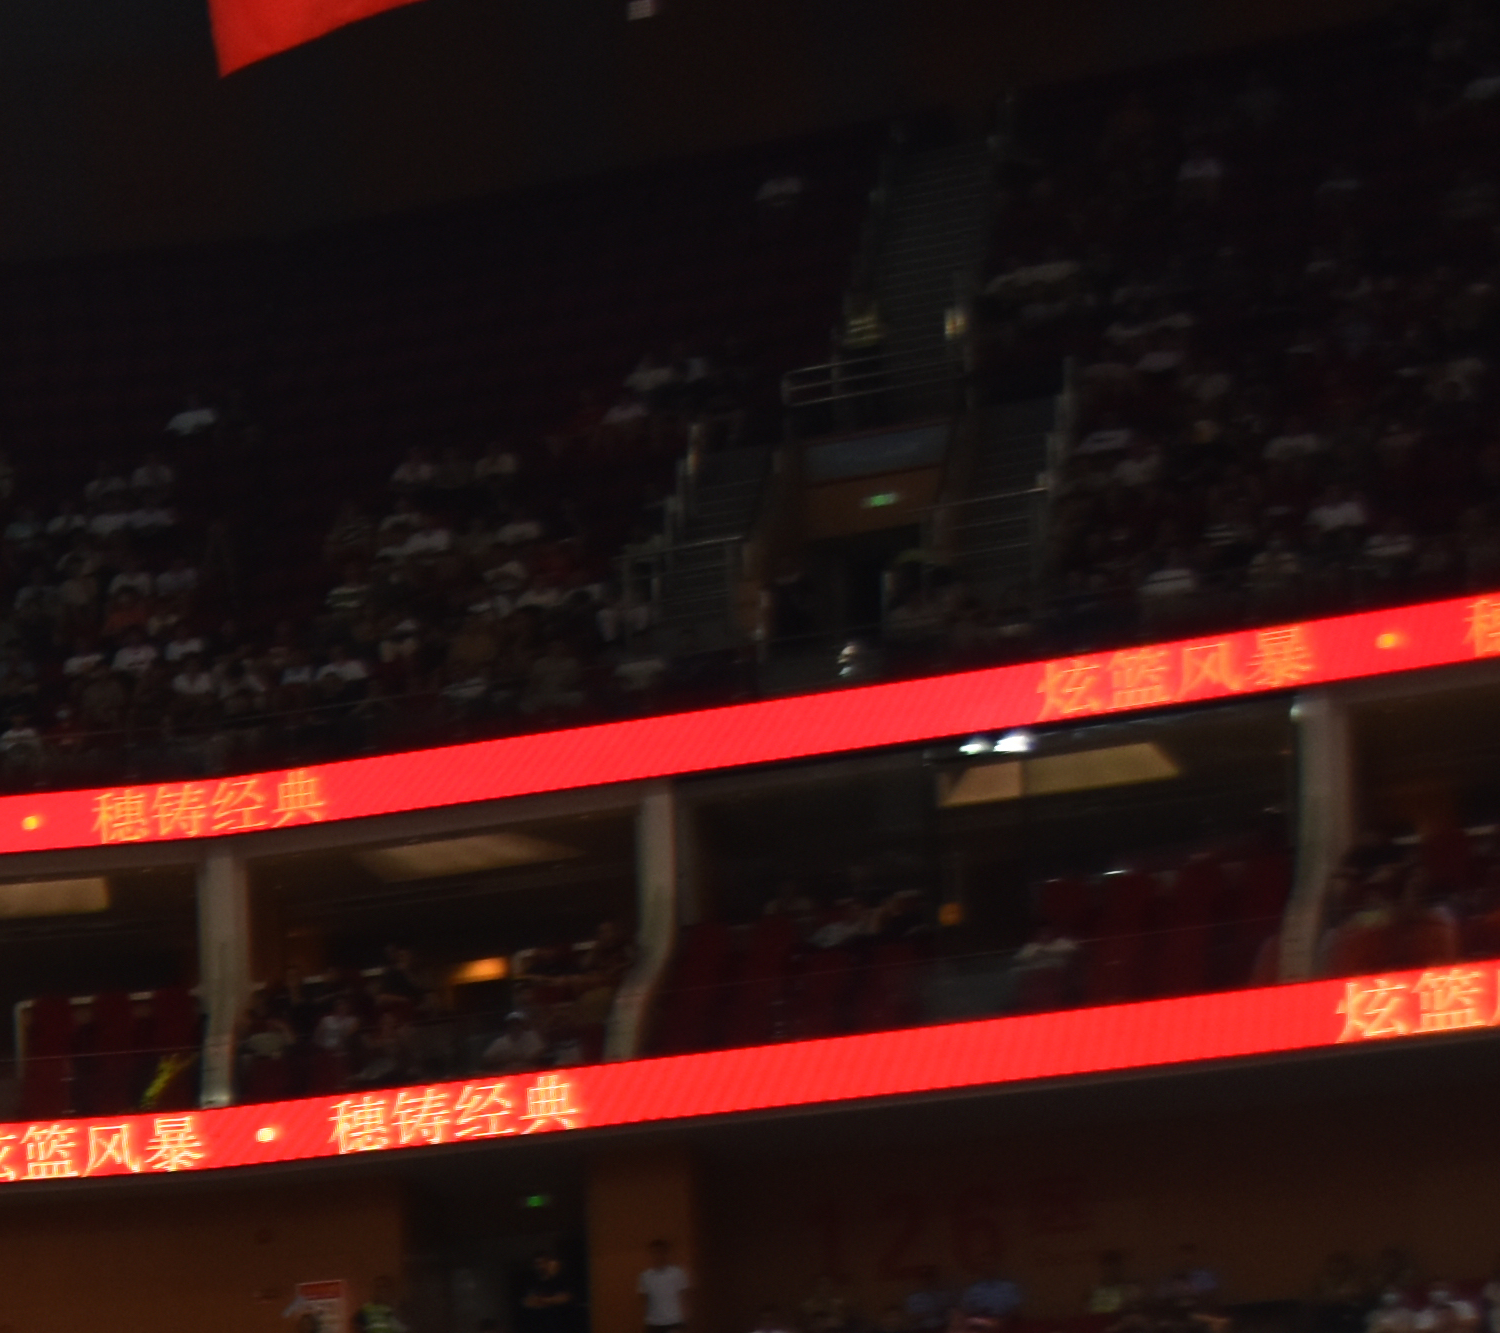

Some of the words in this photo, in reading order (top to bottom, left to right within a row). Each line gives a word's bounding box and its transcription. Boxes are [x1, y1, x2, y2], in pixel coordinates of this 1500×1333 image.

[1036, 624, 1315, 720] 炫篮风暴
[92, 767, 329, 845] 穗铸经典
[1335, 968, 1500, 1044] 炫篮
[328, 1073, 585, 1154] 穗铸经典
